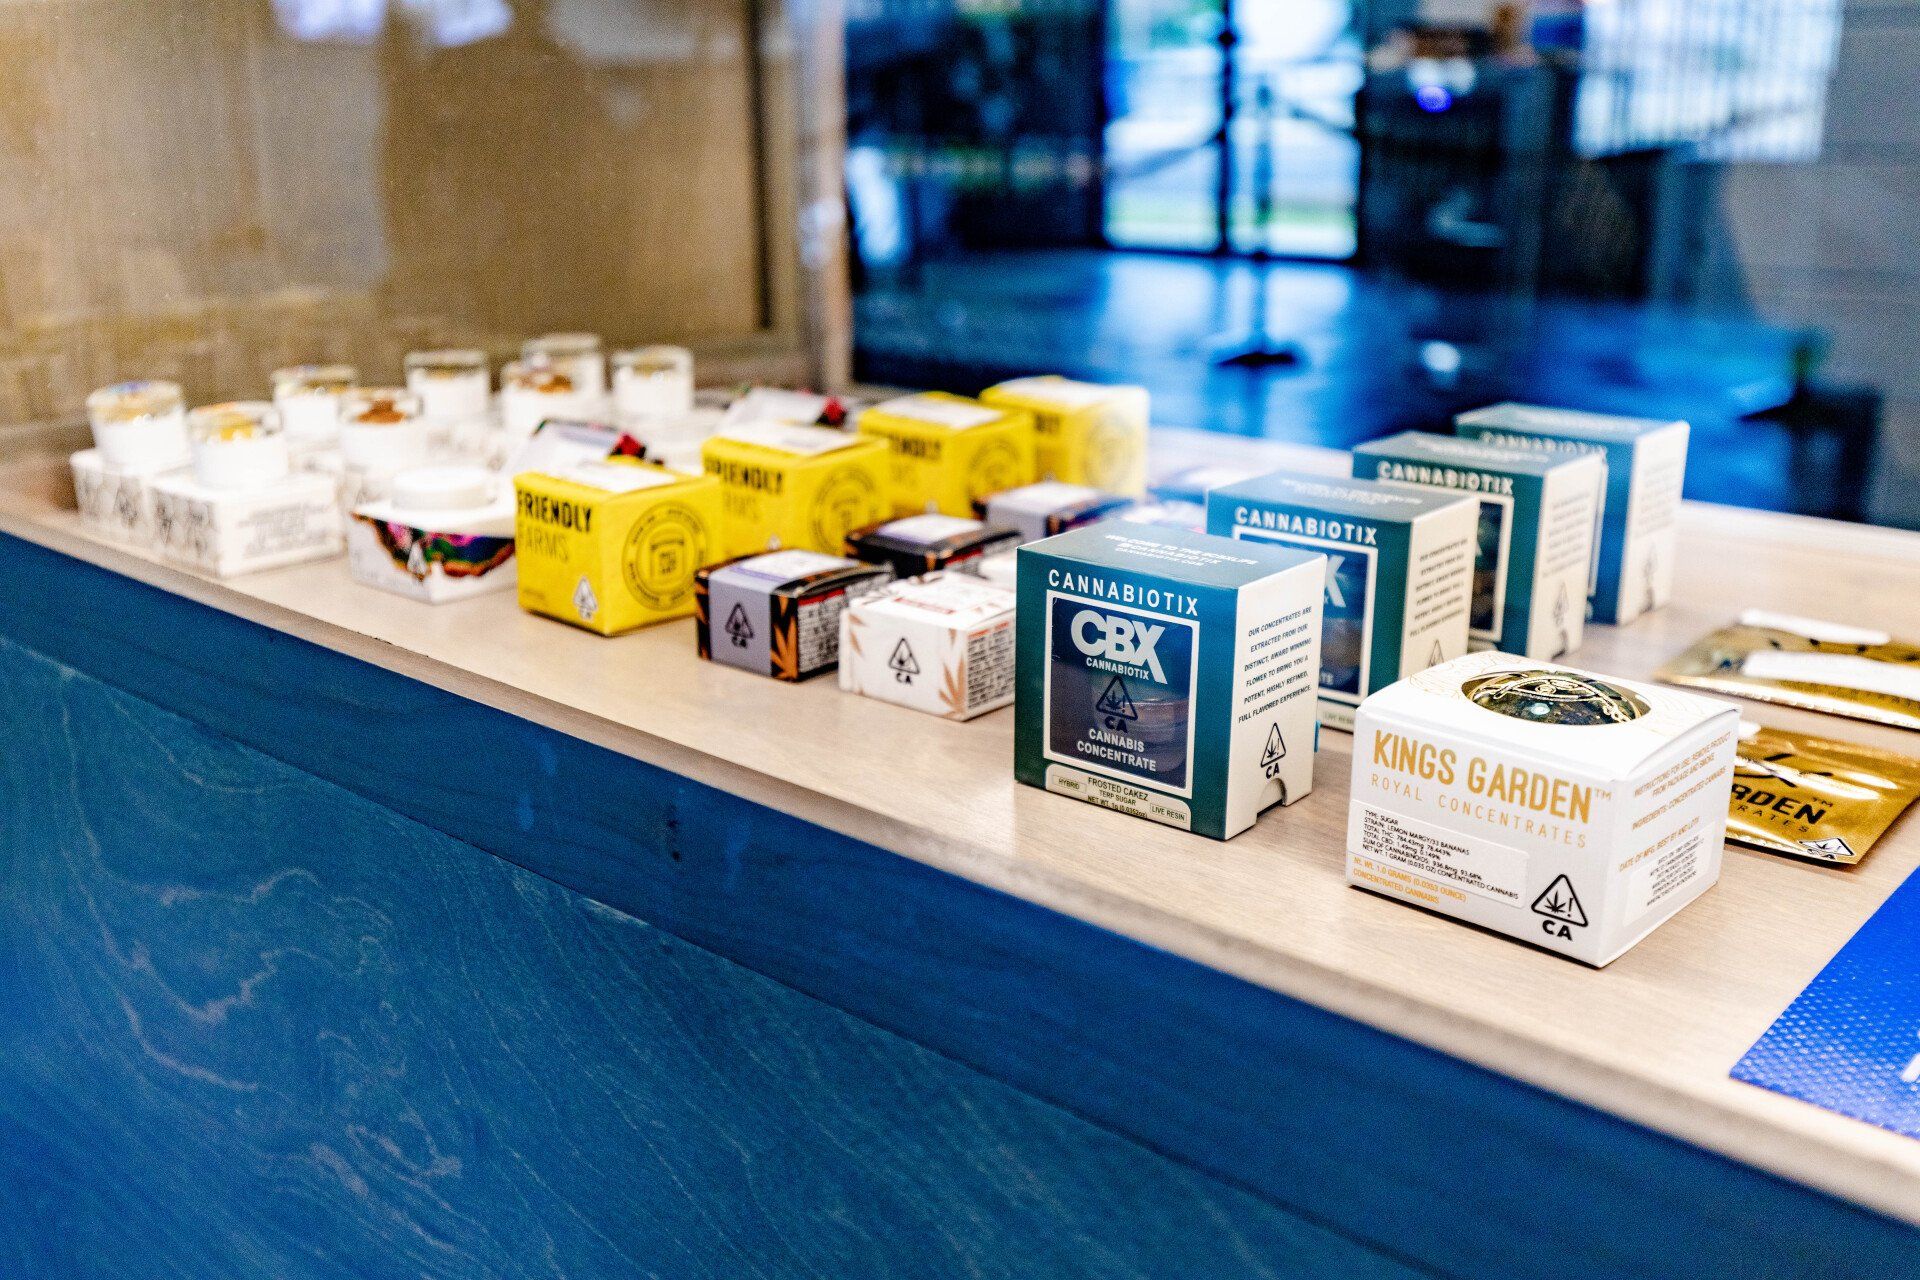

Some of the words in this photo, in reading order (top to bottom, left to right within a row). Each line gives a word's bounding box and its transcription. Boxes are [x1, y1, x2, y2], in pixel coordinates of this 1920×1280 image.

[1377, 460, 1514, 495] CANNABIOTIX
[517, 488, 592, 533] FRIENDLY
[1234, 505, 1378, 546] CANNABIOTIX
[1048, 569, 1198, 617] CANNABIOTIX
[1248, 626, 1260, 637] OUR
[1260, 610, 1301, 632] CONCENTRATES
[1301, 606, 1312, 617] ARE
[1071, 609, 1168, 684] CBX
[1250, 634, 1281, 653] EXTRACTED
[1282, 628, 1297, 641] FROM
[1297, 623, 1309, 635] OUR
[1244, 655, 1270, 672] DISTINCT,
[1270, 646, 1289, 660] AWARD
[1289, 637, 1312, 654] WINNING
[896, 672, 913, 686] CA
[1086, 657, 1150, 681] CANNABIOTIX
[1245, 673, 1268, 687] FLOWER
[1268, 667, 1276, 677] TO
[1276, 662, 1293, 675] BRING
[1293, 657, 1304, 667] YOU
[1243, 689, 1266, 704] POTENT,
[1266, 681, 1285, 695] HIGHLY
[1104, 715, 1129, 734] CA
[1238, 710, 1252, 724] FULL
[1252, 698, 1279, 716] FLAVORED
[1089, 727, 1145, 753] CANNABIS
[1076, 740, 1157, 772] CONCENTRATE
[1265, 762, 1281, 780] CA
[1373, 729, 1457, 785] KINGS
[1467, 757, 1592, 824] GARDEN
[1087, 776, 1122, 794] FROSTED
[1123, 786, 1149, 802] CAKEZ
[1099, 789, 1115, 801] TERP
[1115, 794, 1137, 807] SUGAR
[1151, 804, 1165, 816] LIVE
[1166, 808, 1186, 821] RESIN
[1371, 773, 1422, 801] ROYAL
[1438, 795, 1586, 848] CONCENTRATES
[1731, 783, 1827, 824] RDEN
[1364, 823, 1381, 835] TOTAL
[1380, 815, 1398, 825] SUGAR
[1363, 830, 1381, 842] TOTAL
[1363, 837, 1375, 847] SUM
[1387, 824, 1408, 836] LEMON
[1441, 841, 1470, 855] BANANAS
[1362, 843, 1373, 852] NET
[1389, 852, 1407, 864] GRAM
[1437, 868, 1485, 890] CONCENTRATED
[1486, 883, 1519, 900] CANNABIS
[1388, 868, 1412, 883] GRAMS
[1353, 868, 1404, 892] CONCENTRATED
[1405, 887, 1440, 905] CANNABIS
[1542, 919, 1573, 941] CA
